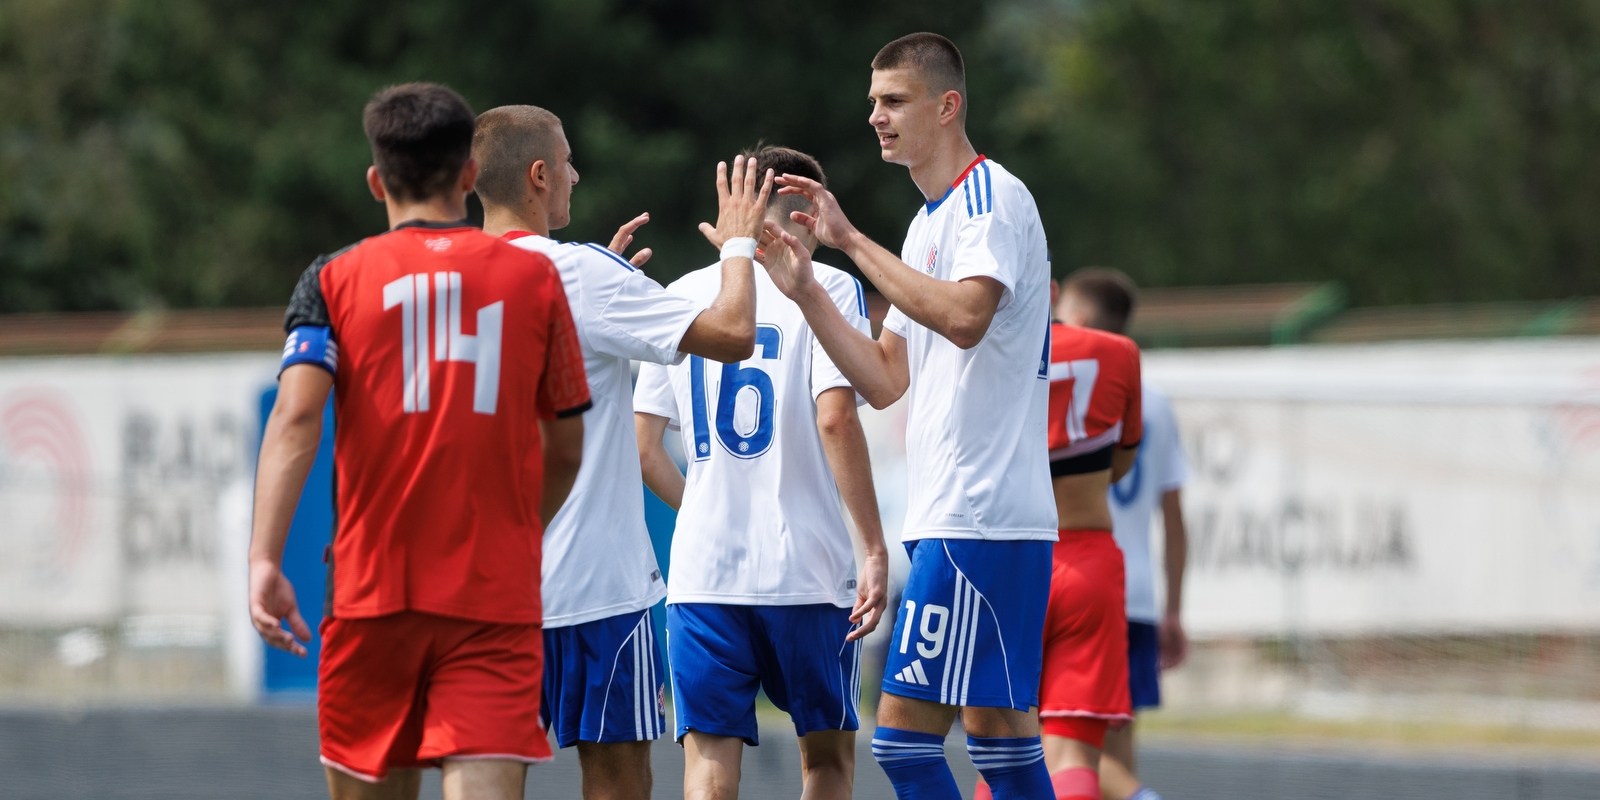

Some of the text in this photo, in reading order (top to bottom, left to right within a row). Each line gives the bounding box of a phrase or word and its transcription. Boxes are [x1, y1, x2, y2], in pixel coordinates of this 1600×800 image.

[383, 271, 504, 415] 14
[688, 322, 783, 462] 16
[899, 600, 949, 659] 19
